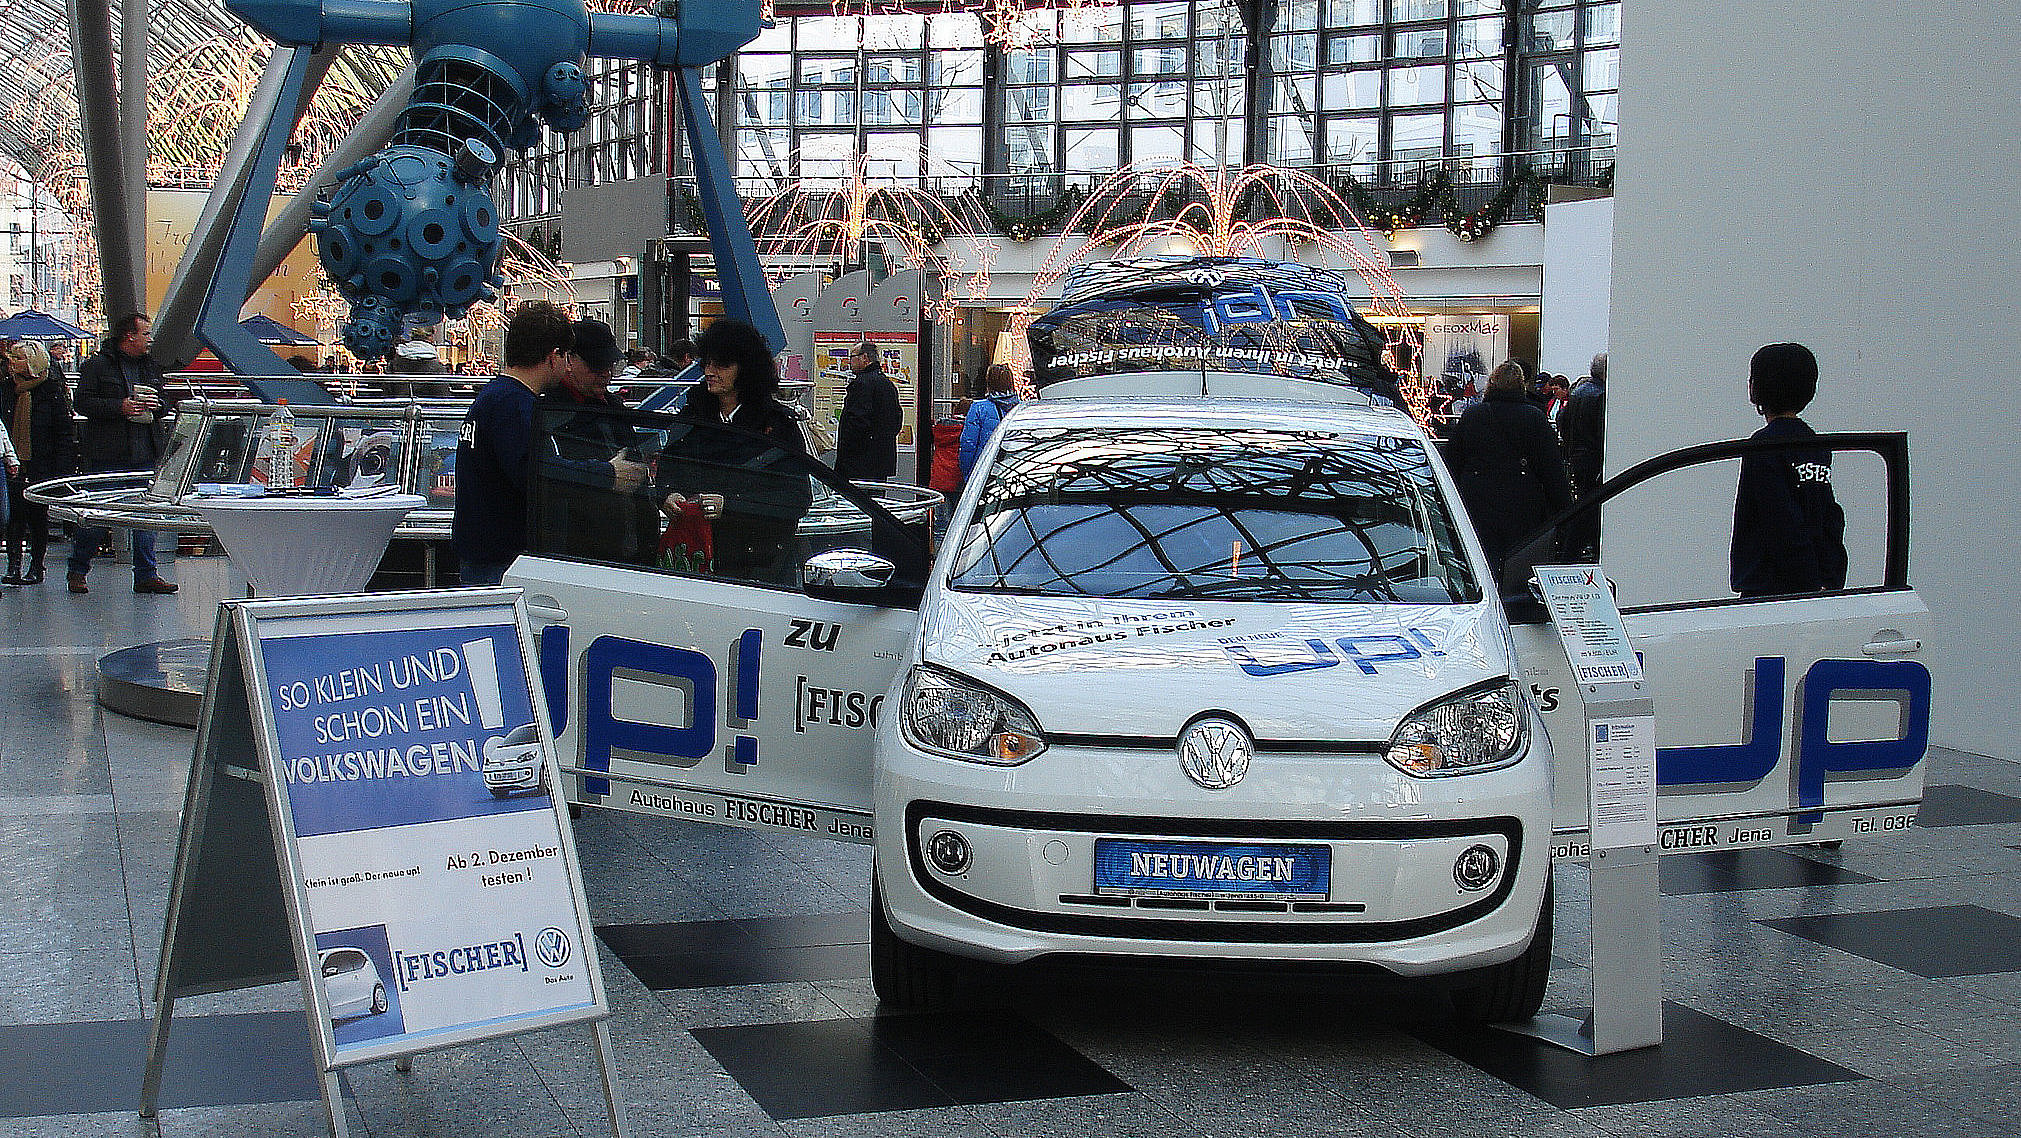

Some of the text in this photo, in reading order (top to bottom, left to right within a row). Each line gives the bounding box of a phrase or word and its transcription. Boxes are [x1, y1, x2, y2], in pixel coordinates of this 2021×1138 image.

[1048, 348, 1115, 370] Fischer
[1119, 346, 1211, 362] Autohaus
[1215, 347, 1271, 364] Ihrem
[1074, 619, 1104, 630] in
[1113, 609, 1196, 624] Ihrem
[1136, 616, 1237, 636] Fischer
[783, 617, 842, 653] zu
[278, 646, 461, 711] SO KLEIN UND
[1577, 663, 1630, 682] [FISCHER]
[313, 692, 472, 745] SCHON EIN
[283, 738, 483, 785] VOLKSWAGEN
[628, 788, 874, 839] Autohaus FISCHER Jena
[1728, 828, 1772, 844] Jena
[1851, 816, 1878, 834] Tel.
[446, 844, 559, 871] Ab 2. Dezember
[1130, 851, 1295, 881] NEUWAGEN
[328, 876, 339, 886] ist
[365, 871, 381, 881] Der
[383, 869, 405, 879] neue
[481, 872, 523, 888] testen
[395, 932, 529, 992] [FISCHER]
